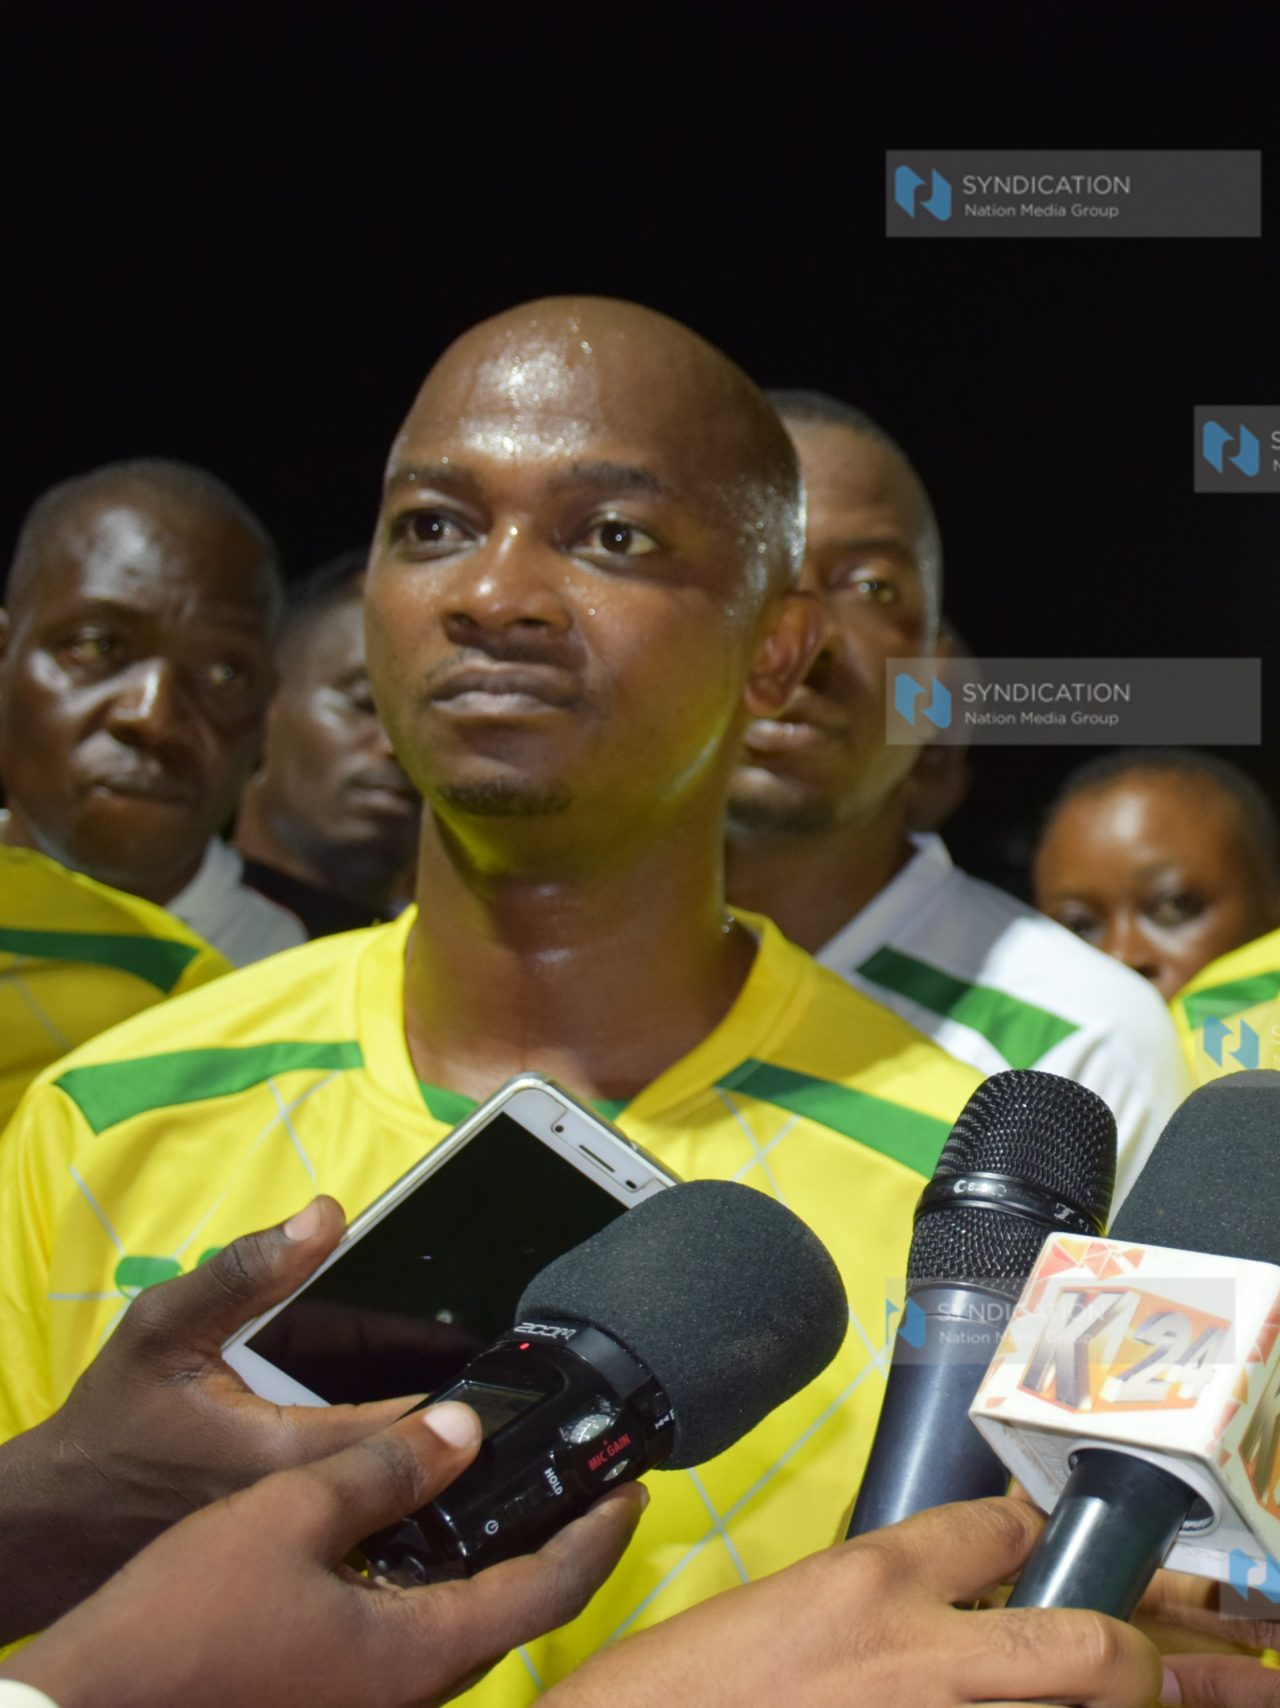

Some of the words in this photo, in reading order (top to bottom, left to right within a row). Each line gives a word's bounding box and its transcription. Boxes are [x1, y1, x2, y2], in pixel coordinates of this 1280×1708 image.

[588, 1453, 608, 1472] MIC
[608, 1434, 631, 1457] GAIN
[544, 1468, 563, 1496] HOLD
